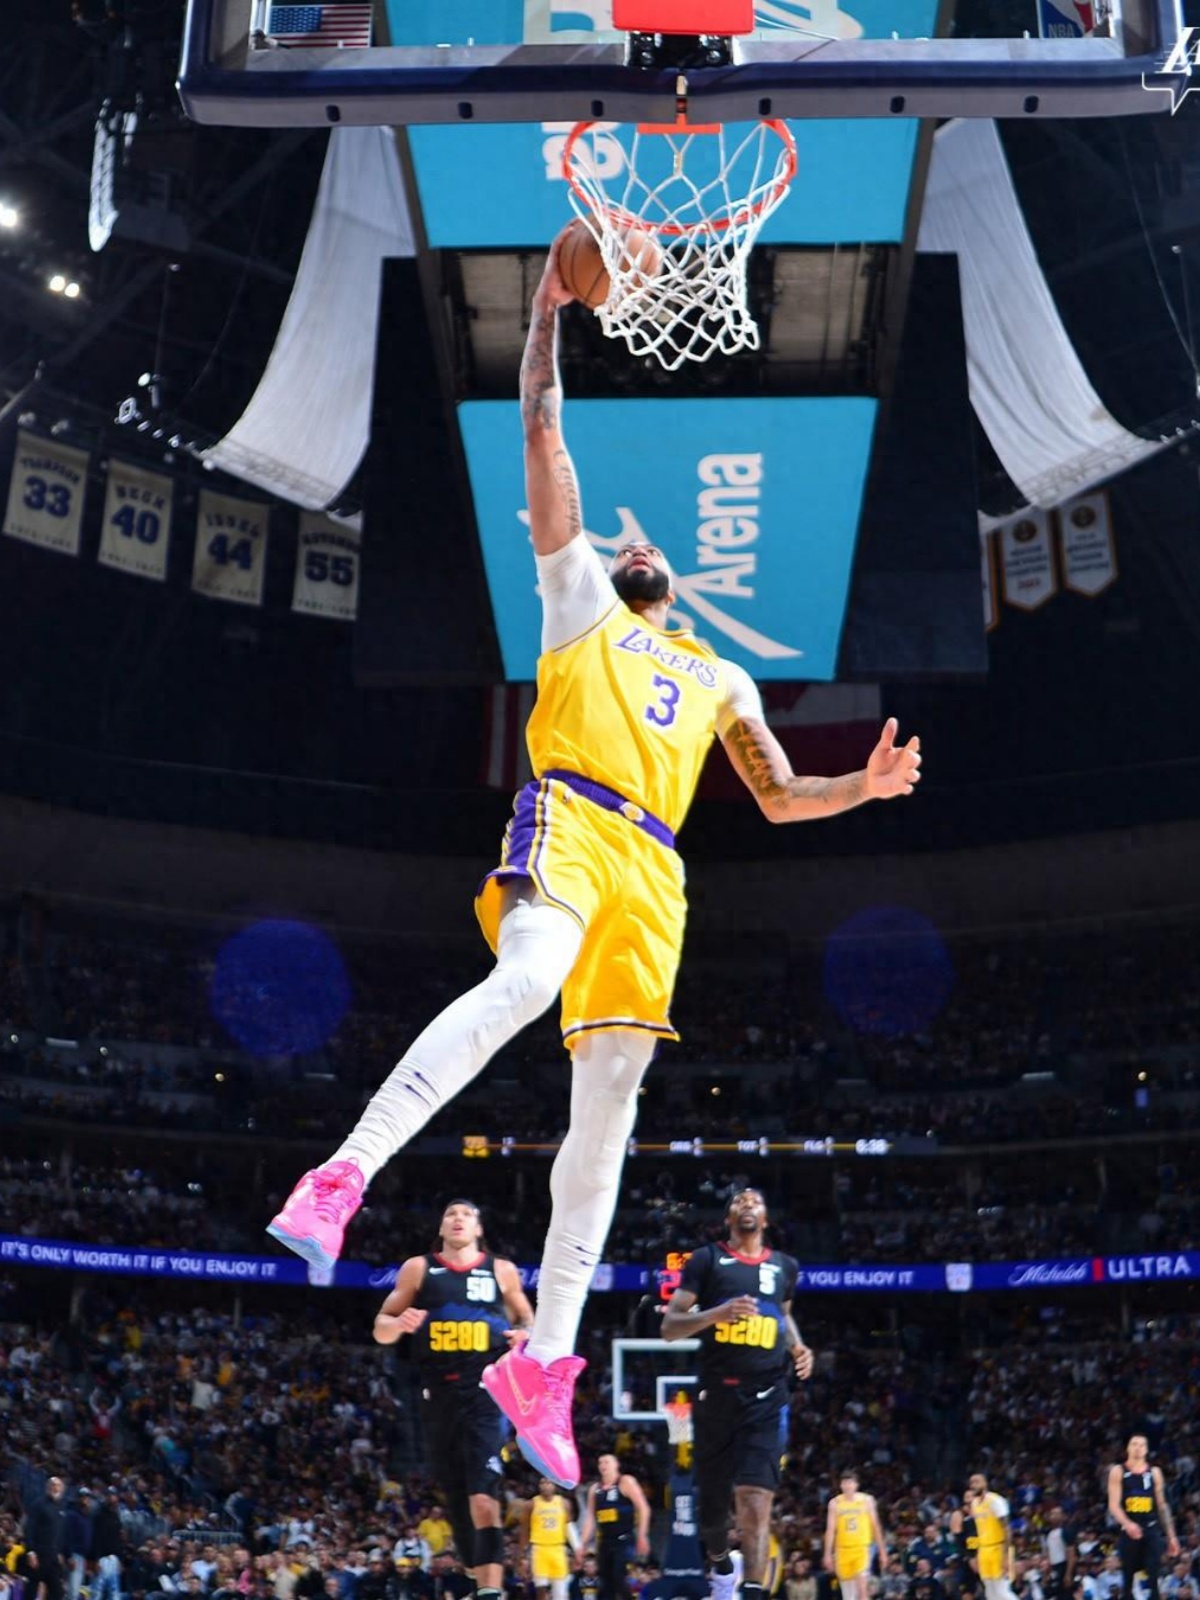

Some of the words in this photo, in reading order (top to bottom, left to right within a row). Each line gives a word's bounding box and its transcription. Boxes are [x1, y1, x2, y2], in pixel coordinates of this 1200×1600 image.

[23, 476, 72, 518] 33
[112, 504, 160, 545] 40
[697, 453, 763, 598] Arena
[208, 533, 253, 570] 44
[305, 551, 354, 586] 55
[616, 626, 718, 687] LAKERS
[645, 675, 680, 727] 3
[1, 1241, 29, 1257] IT'S
[31, 1245, 70, 1262] ONLY
[73, 1249, 130, 1267] WORTH
[133, 1253, 149, 1269] IT
[151, 1255, 165, 1270] IF
[169, 1256, 201, 1273] YOU
[206, 1259, 257, 1276] ENJOY
[261, 1262, 276, 1277] IT
[1008, 1263, 1087, 1284] Michelob
[1109, 1255, 1190, 1279] ULTRA
[466, 1276, 496, 1303] 50
[759, 1269, 776, 1294] 5
[808, 1271, 840, 1285] YOU
[844, 1271, 896, 1286] ENJOY
[899, 1271, 914, 1284] IT
[430, 1321, 489, 1352] 5280
[715, 1314, 778, 1350] 5280
